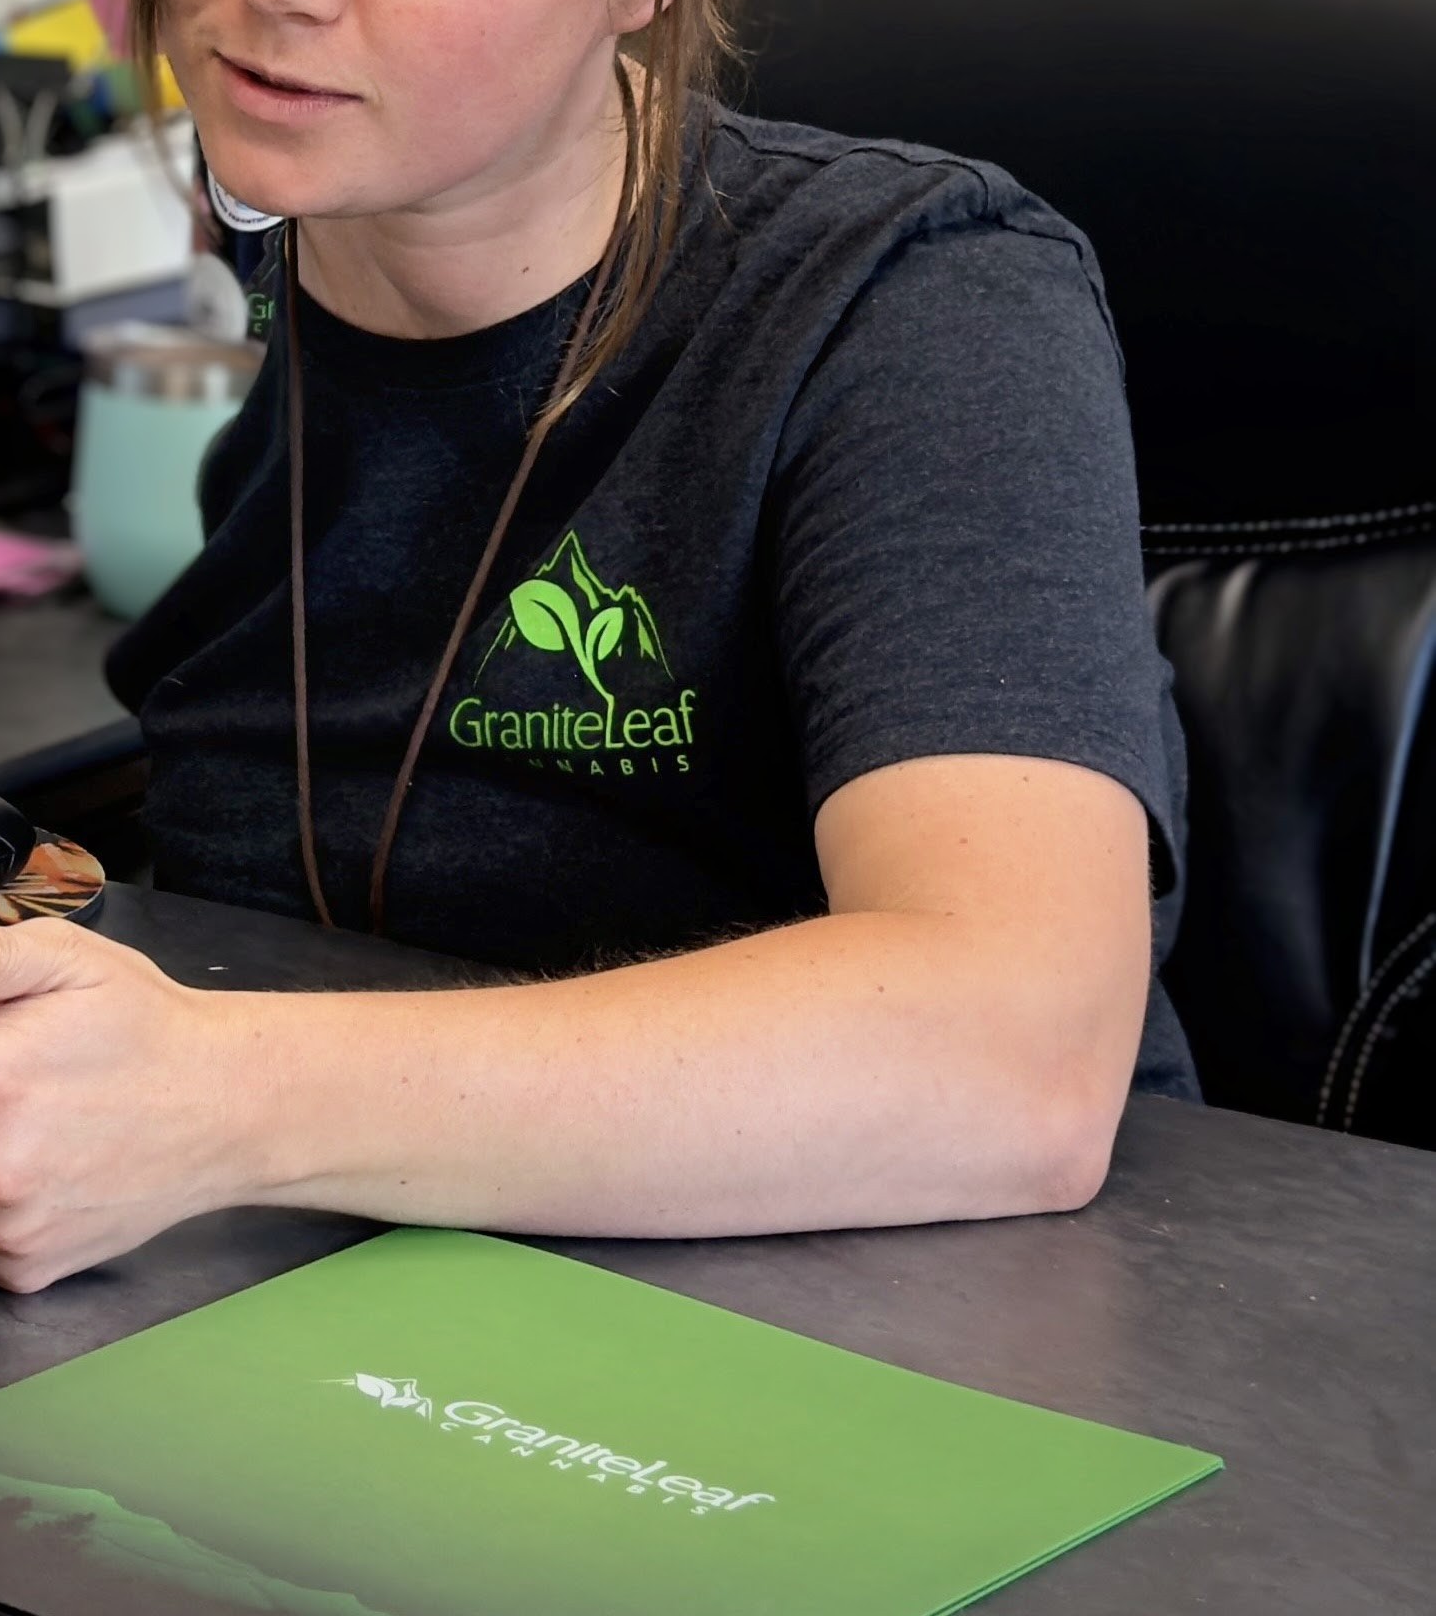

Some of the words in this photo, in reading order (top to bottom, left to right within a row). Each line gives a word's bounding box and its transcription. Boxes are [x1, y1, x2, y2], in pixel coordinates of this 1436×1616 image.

[449, 689, 696, 750] GraniteLeaf
[439, 1421, 710, 1516] CANNABIS
[443, 1400, 776, 1512] GraniteLeaf
